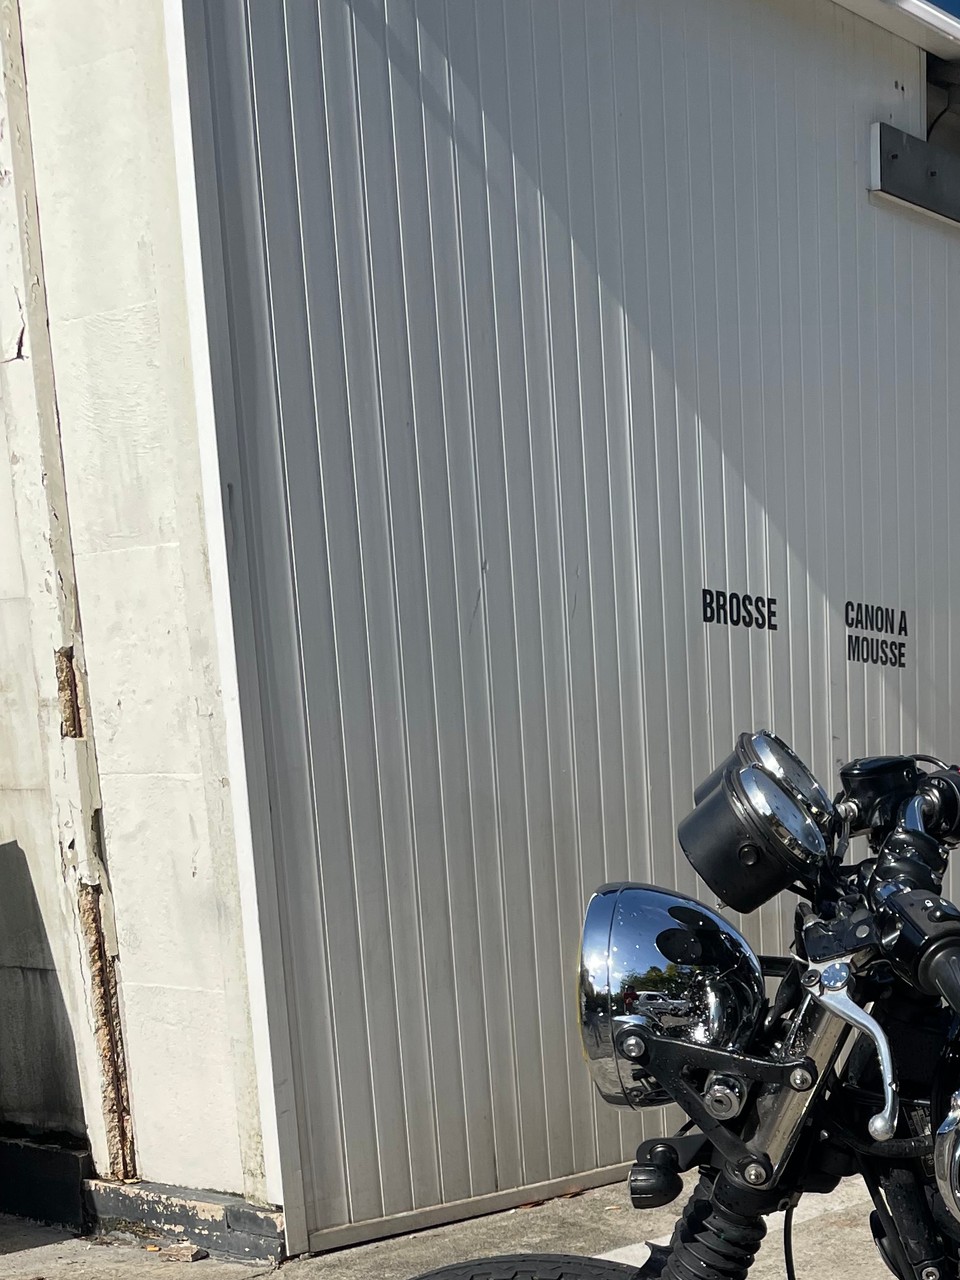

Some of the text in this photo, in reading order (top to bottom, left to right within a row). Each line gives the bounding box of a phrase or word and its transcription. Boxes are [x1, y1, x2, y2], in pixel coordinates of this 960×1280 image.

[702, 589, 777, 630] BROSSE
[845, 601, 908, 636] CANON A
[848, 635, 906, 668] MOUSSE
